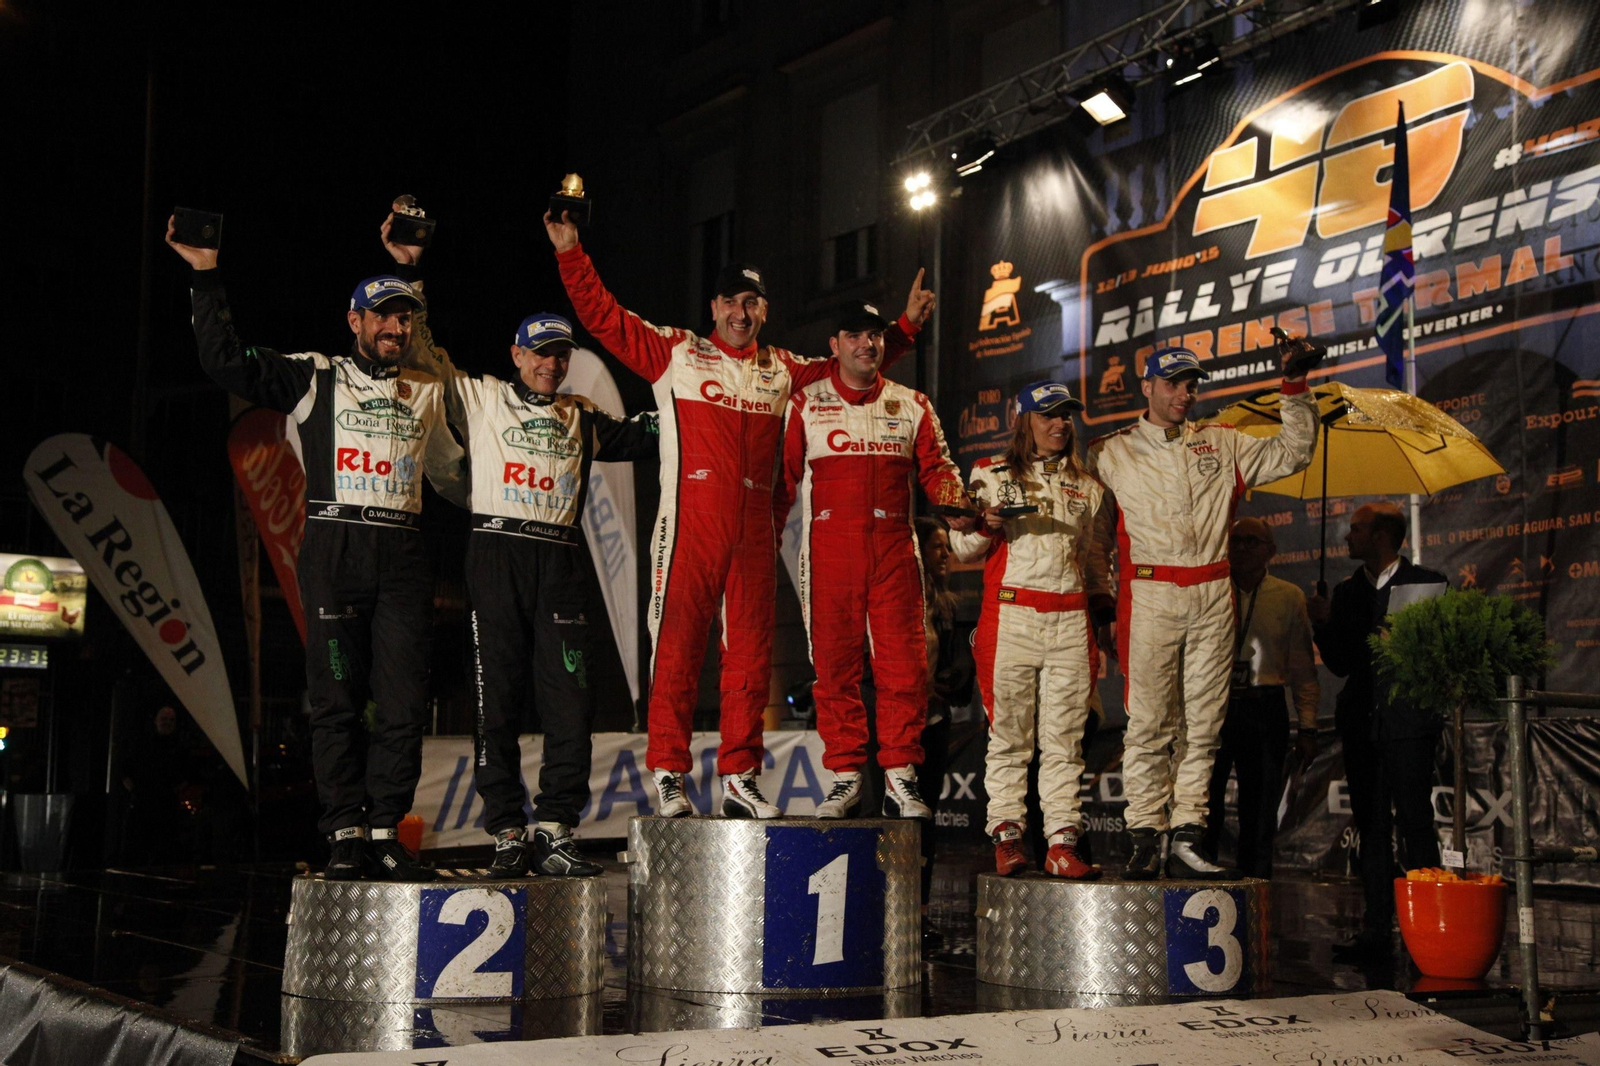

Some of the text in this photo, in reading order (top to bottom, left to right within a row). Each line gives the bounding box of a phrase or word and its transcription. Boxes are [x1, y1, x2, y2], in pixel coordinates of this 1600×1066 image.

[1095, 258, 1298, 347] RALLYE
[346, 413, 380, 428] Doña
[511, 431, 541, 446] Doña
[337, 447, 392, 475] Rio
[503, 462, 554, 491] Rio
[368, 511, 407, 521] D.VALLEJO
[1506, 522, 1520, 535] DE
[1569, 512, 1592, 527] SAN
[34, 453, 206, 677] La Región
[1136, 567, 1153, 577] OMP
[998, 591, 1016, 600] OMP
[1081, 811, 1124, 832] Swiss
[807, 853, 849, 967] 1
[431, 889, 516, 999] 2
[1181, 888, 1244, 993] 3
[1014, 1016, 1153, 1045] Sierra
[1178, 1014, 1312, 1031] EDOX
[815, 1038, 979, 1058] EDOX
[905, 1052, 984, 1064] Watches
[1440, 1041, 1569, 1057] EDOX
